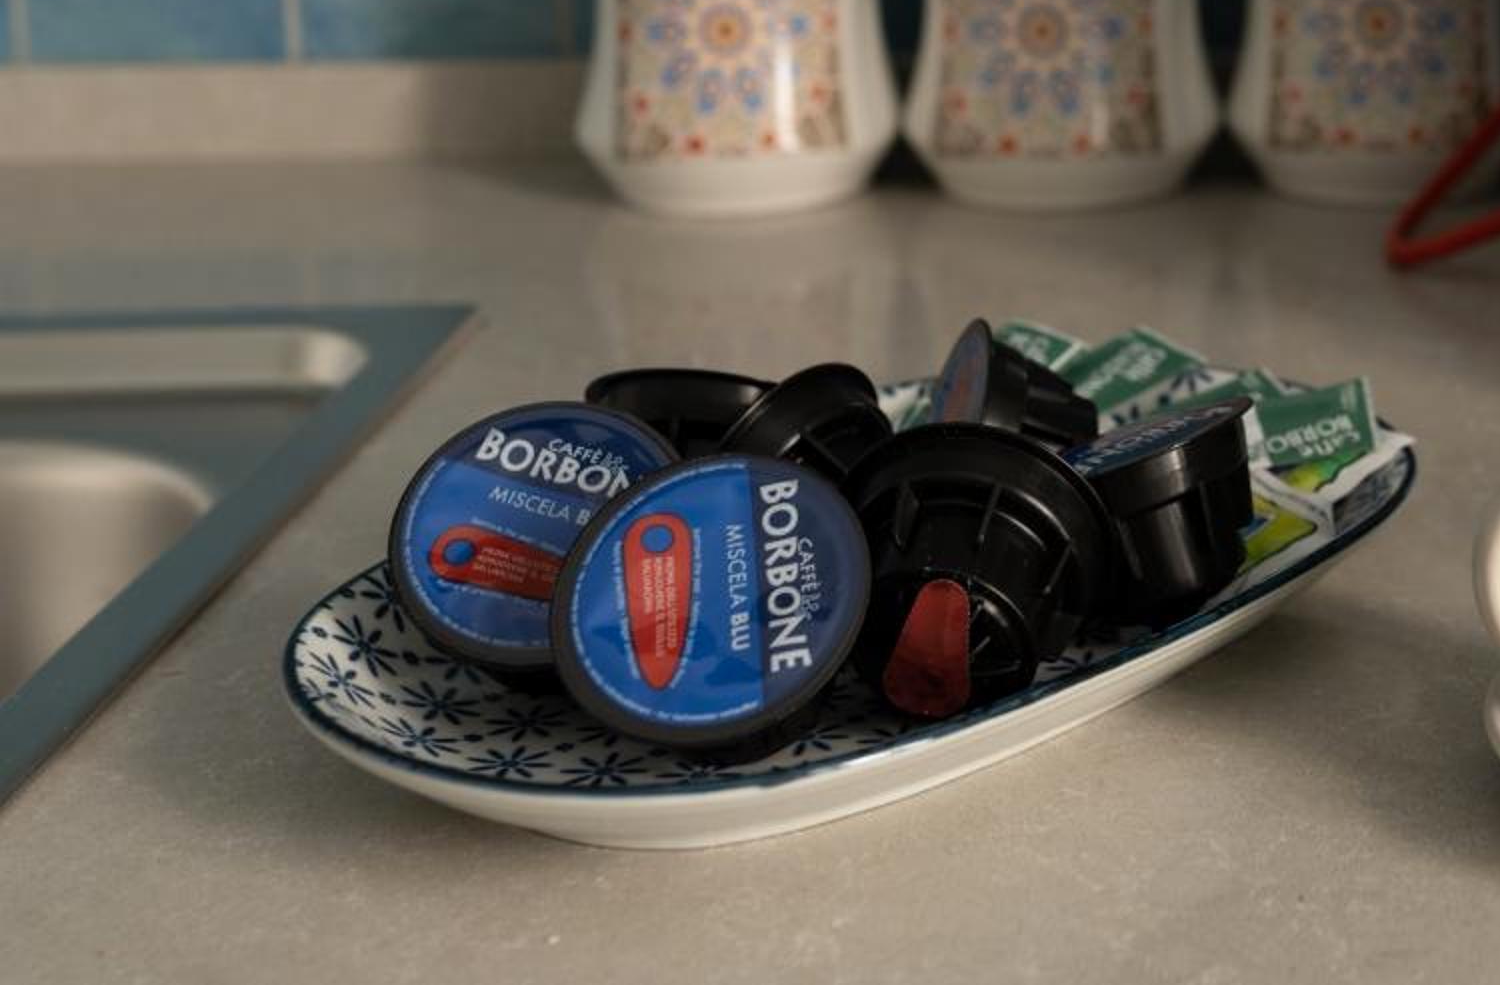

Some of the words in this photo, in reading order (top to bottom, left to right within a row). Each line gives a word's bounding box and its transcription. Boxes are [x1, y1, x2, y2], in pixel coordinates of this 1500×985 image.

[475, 427, 630, 498] BORBON
[488, 485, 570, 521] MISCELA
[725, 523, 748, 610] MISCELA
[759, 479, 813, 674] BORBONE
[730, 611, 751, 653] BLU
